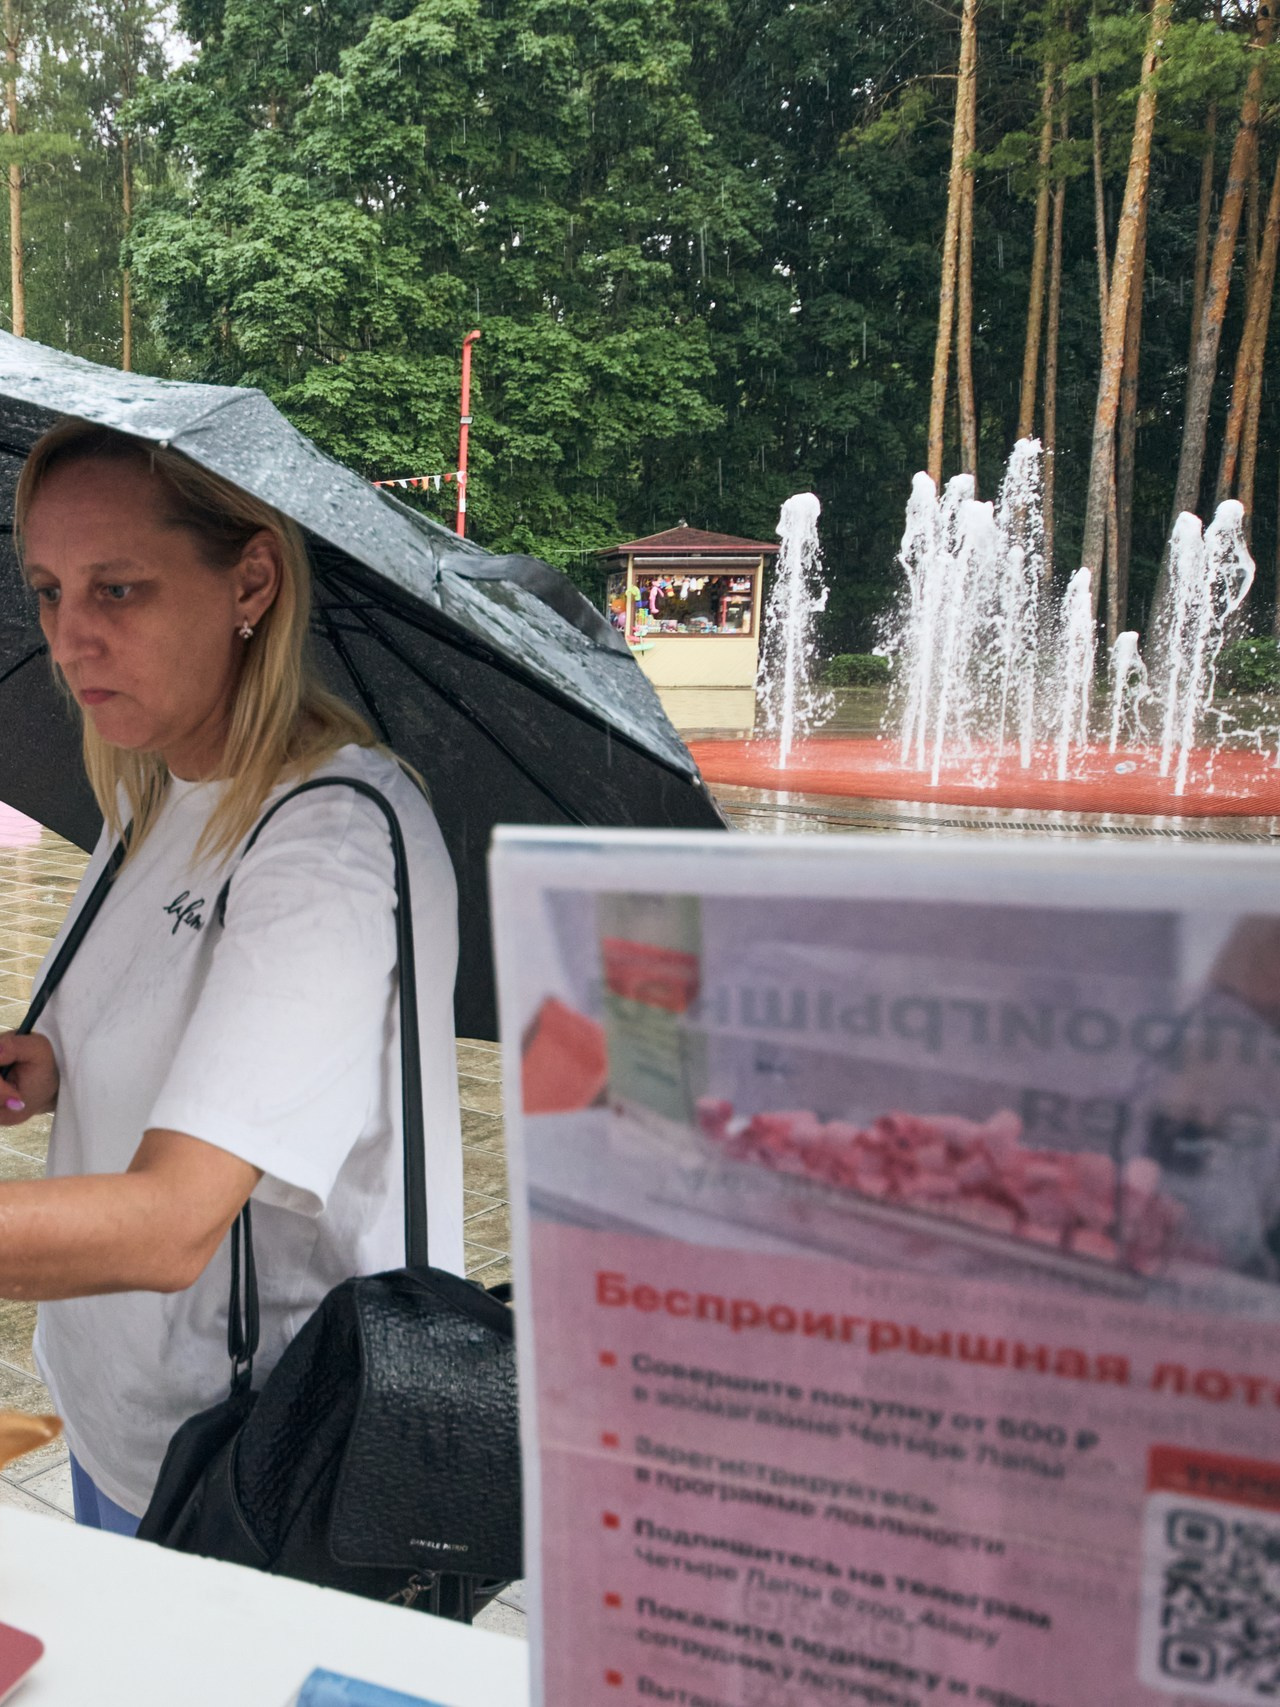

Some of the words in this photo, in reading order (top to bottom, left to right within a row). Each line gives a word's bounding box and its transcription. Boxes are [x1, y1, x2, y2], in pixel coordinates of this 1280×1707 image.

[594, 1270, 1131, 1386] Беспроигрышная
[1151, 1360, 1280, 1408] лот
[631, 1351, 803, 1400] Совершите
[811, 1385, 945, 1430] покупку
[950, 1411, 987, 1433] от
[996, 1416, 1067, 1448] 500
[656, 1389, 844, 1439] зоомагазине
[848, 1421, 966, 1461] Четыре
[634, 1434, 939, 1515] Зарегистрируйтесь
[655, 1471, 817, 1517] программе
[823, 1503, 1006, 1556] лояльности
[634, 1546, 739, 1582] Четыре
[634, 1517, 842, 1578] Подпишитесь
[848, 1565, 887, 1589] на
[895, 1575, 1053, 1631] телеграм
[636, 1595, 786, 1649] Покажите
